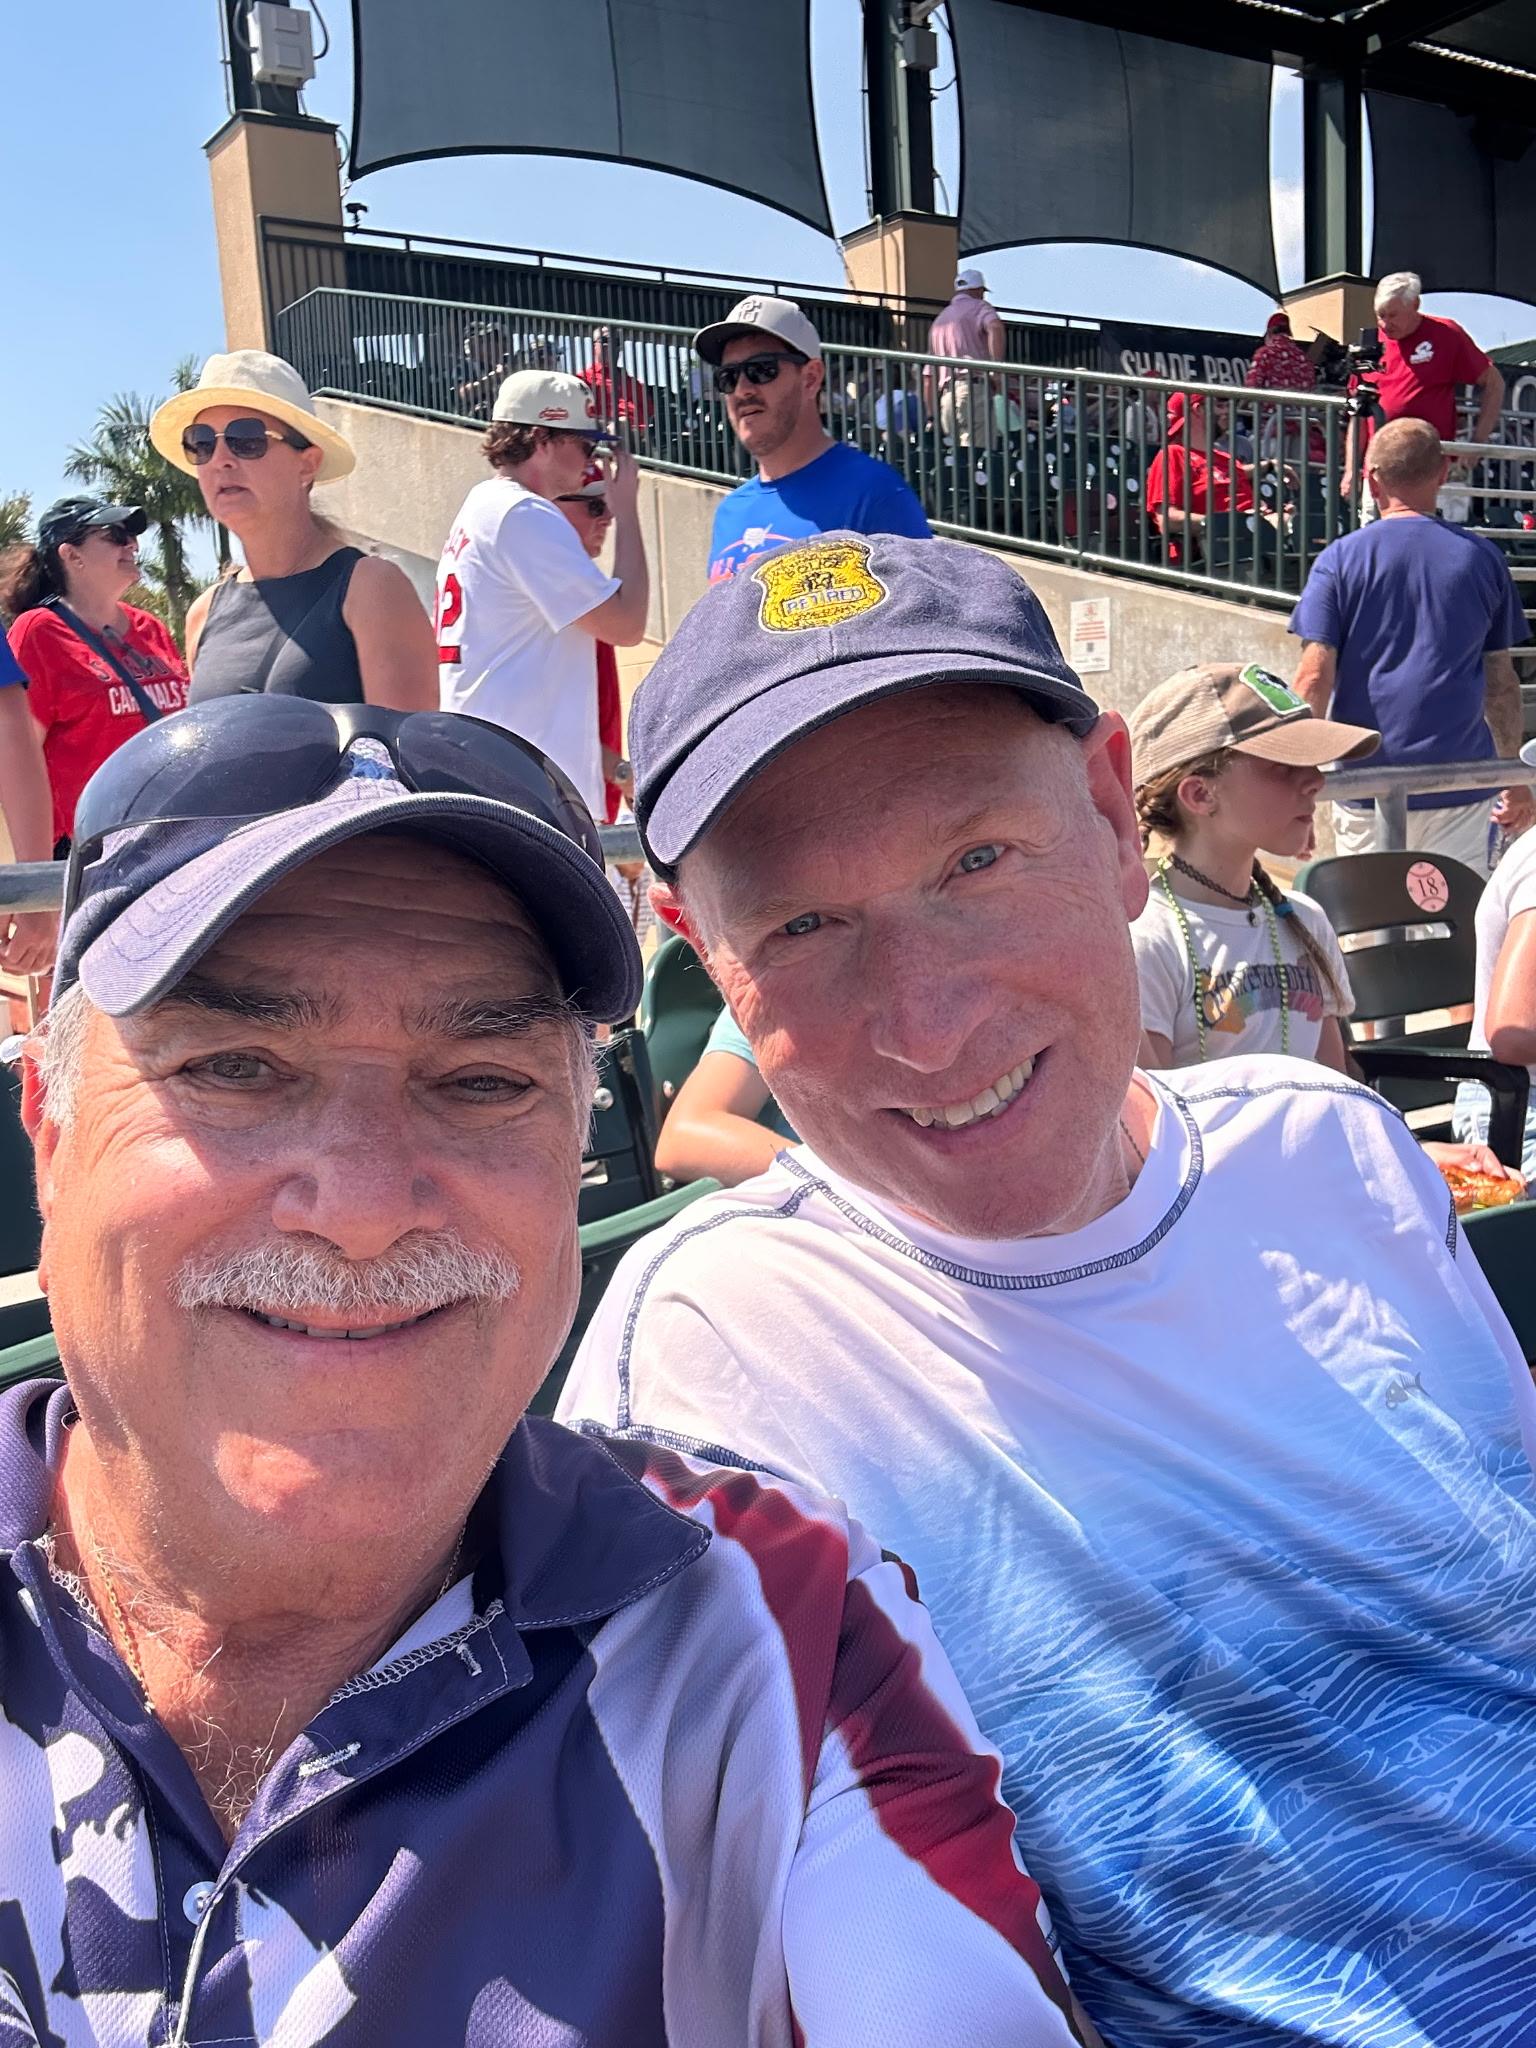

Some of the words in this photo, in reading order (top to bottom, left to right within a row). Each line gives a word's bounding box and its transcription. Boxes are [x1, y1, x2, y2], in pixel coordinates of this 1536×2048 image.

[1120, 350, 1197, 382] SHADE
[786, 586, 864, 615] RETIRED
[1418, 877, 1439, 897] 18
